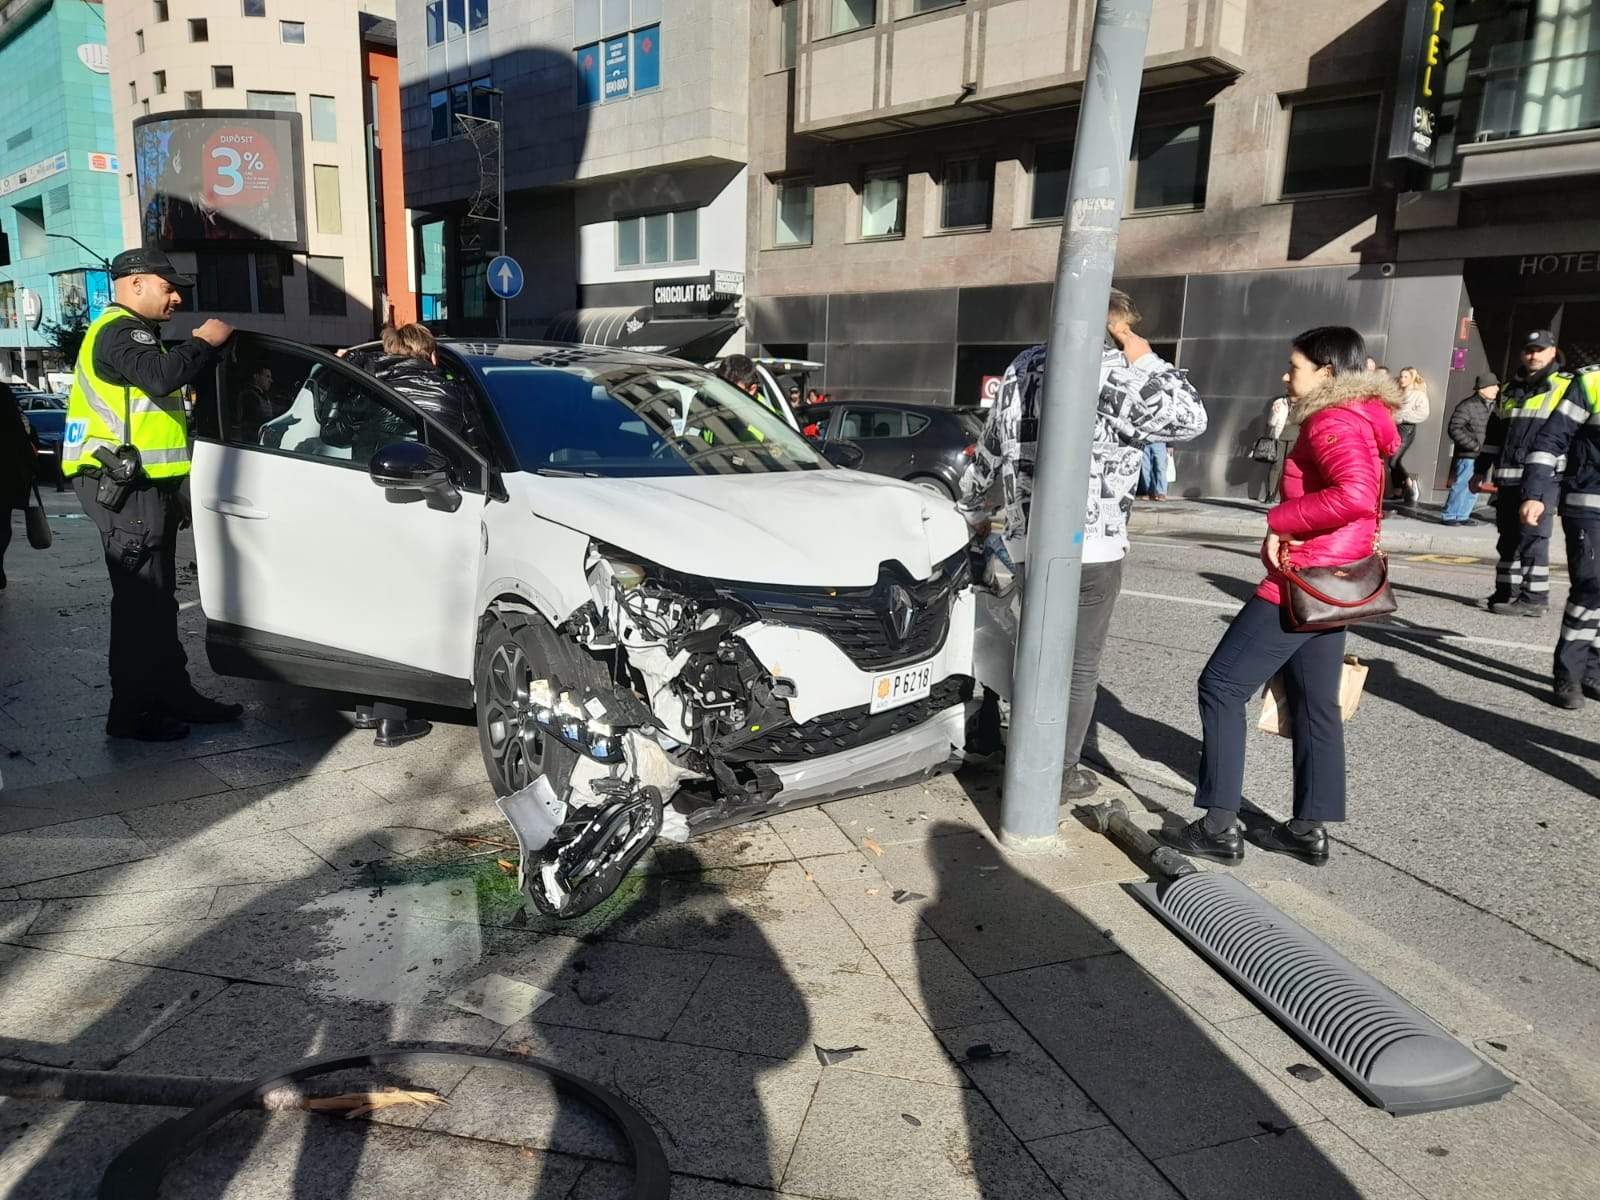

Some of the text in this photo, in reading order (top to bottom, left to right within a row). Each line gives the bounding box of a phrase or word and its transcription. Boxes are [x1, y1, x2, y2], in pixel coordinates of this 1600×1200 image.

[1424, 0, 1445, 97] TEL
[655, 285, 694, 304] CHOCOLAT
[893, 676, 900, 697] P
[903, 668, 929, 694] 6218
